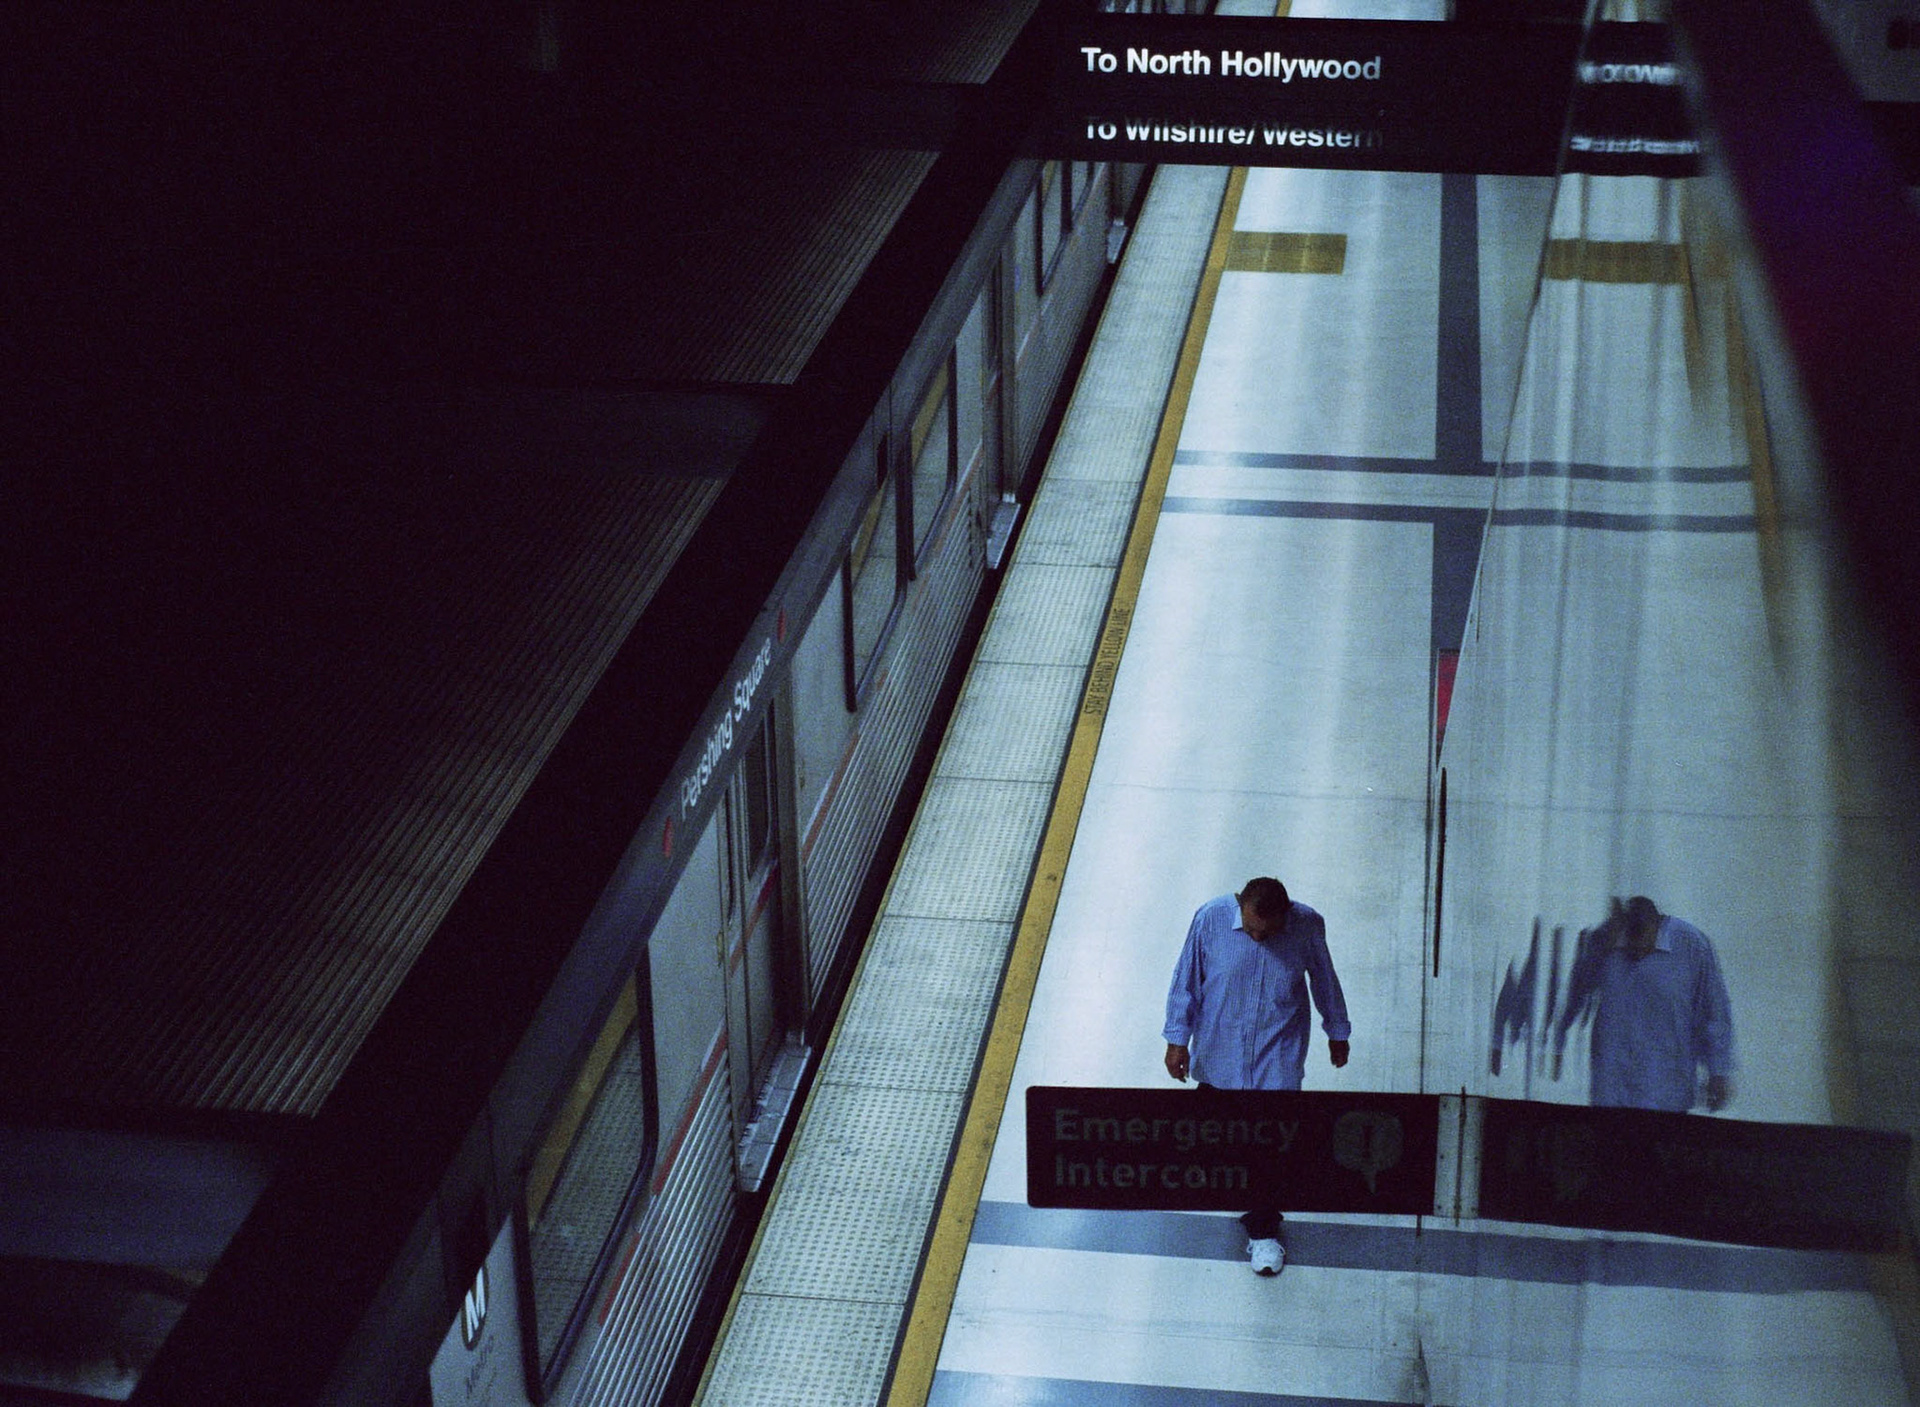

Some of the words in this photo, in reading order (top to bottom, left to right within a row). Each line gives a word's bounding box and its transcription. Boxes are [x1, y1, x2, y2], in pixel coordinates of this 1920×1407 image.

[1080, 47, 1118, 73] To
[1126, 48, 1211, 76] North
[1220, 50, 1381, 84] Hollywood
[1084, 116, 1118, 141] To
[681, 707, 733, 821] Pershing
[734, 637, 772, 722] Square
[1055, 1108, 1300, 1152] Emergency
[1055, 1153, 1249, 1189] Intercom
